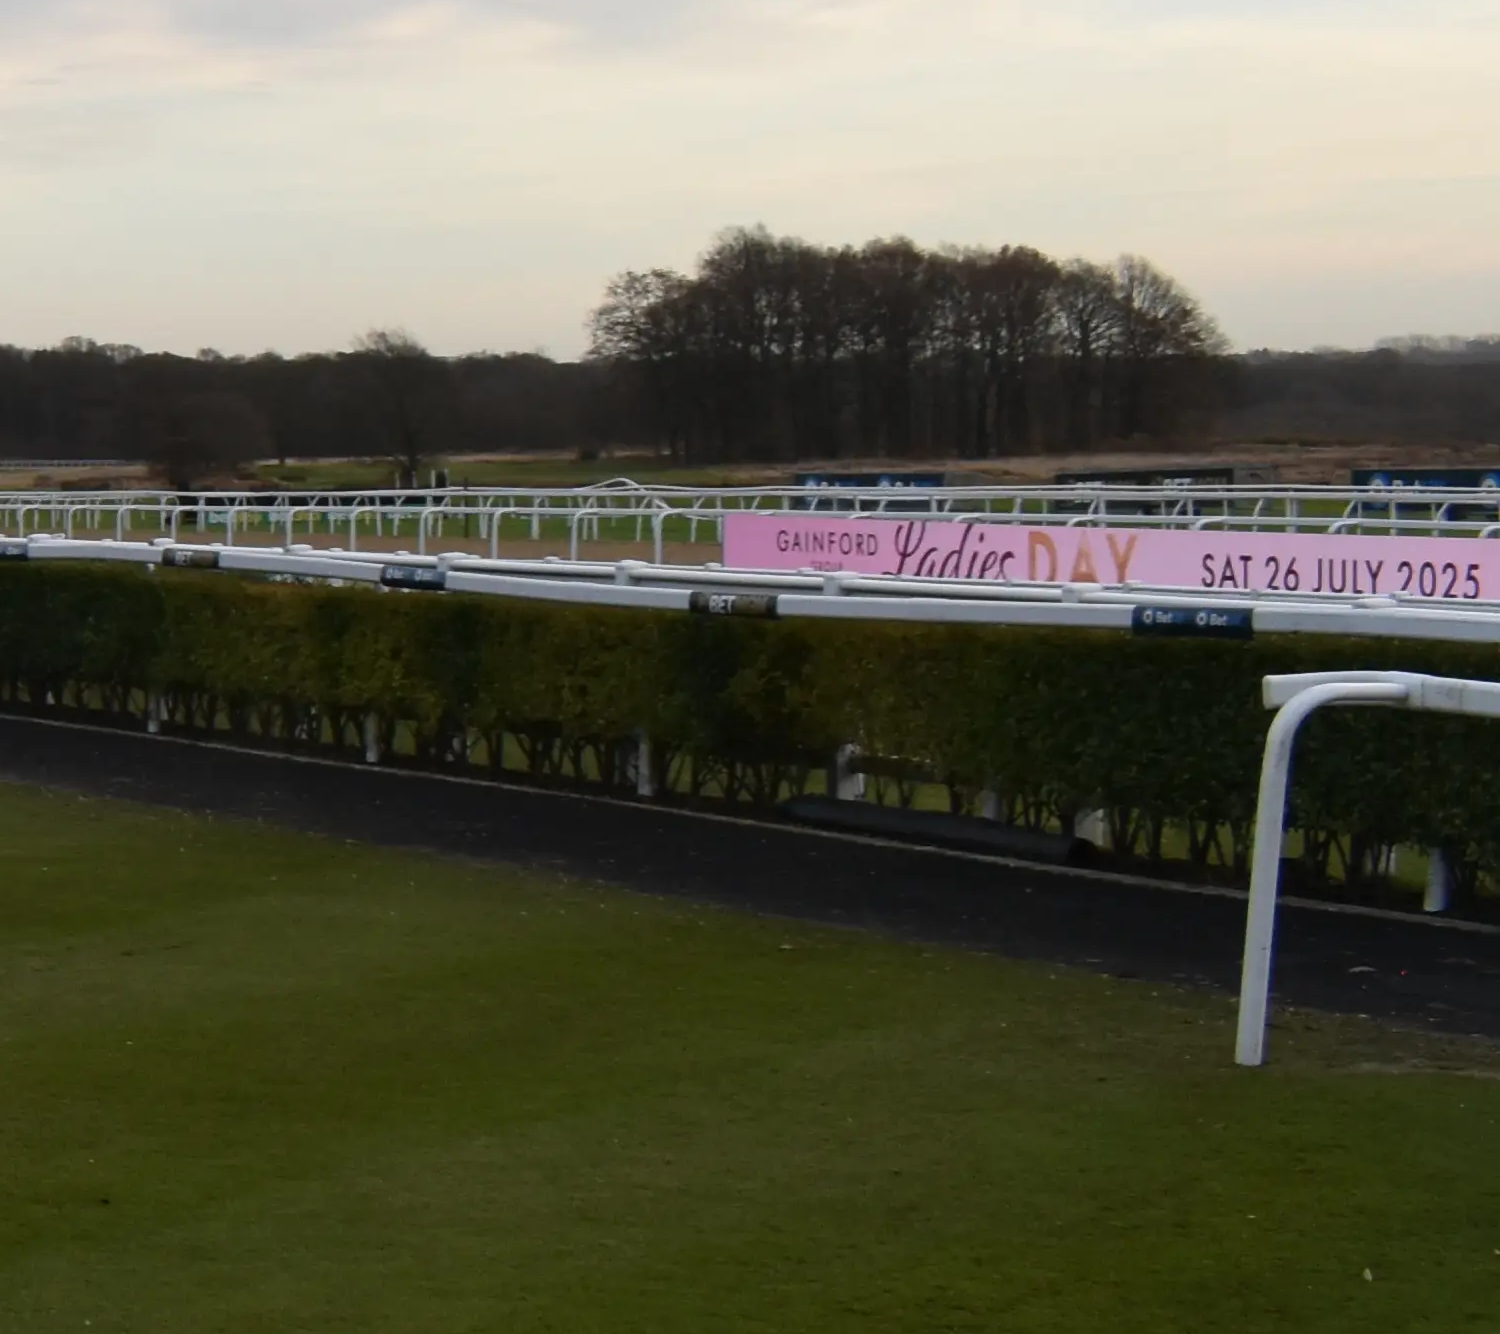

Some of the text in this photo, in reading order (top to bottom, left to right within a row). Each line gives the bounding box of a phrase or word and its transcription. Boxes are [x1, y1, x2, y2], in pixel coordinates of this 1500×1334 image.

[776, 529, 878, 557] GAINFORD
[882, 521, 1138, 583] Ladies DAY
[1201, 553, 1481, 600] SAT 26 JULY 2025
